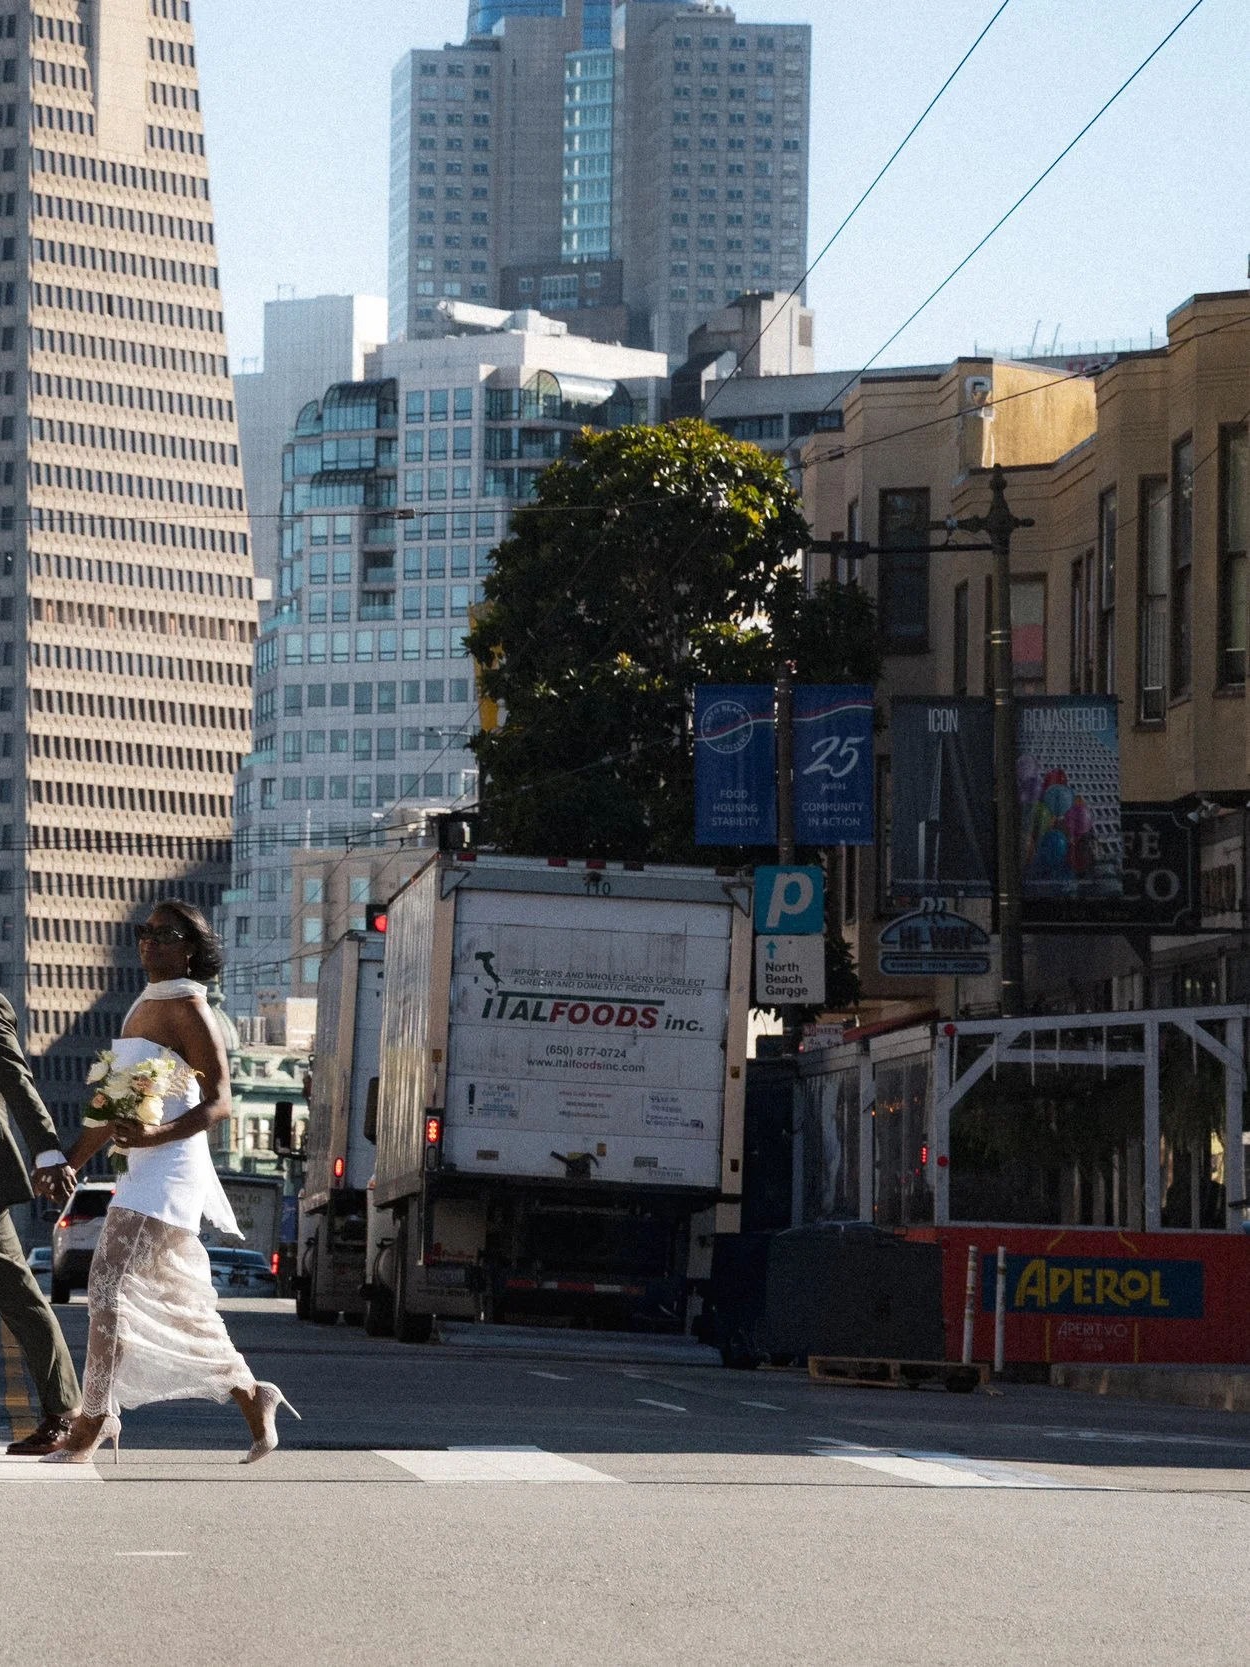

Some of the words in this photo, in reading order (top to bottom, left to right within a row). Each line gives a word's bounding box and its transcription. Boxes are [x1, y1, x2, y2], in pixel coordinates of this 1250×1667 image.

[928, 709, 958, 732] ICON
[1024, 708, 1108, 732] REMASTERED
[802, 736, 866, 778] 25
[720, 789, 748, 799] FOOD
[713, 803, 758, 813] HOUSING
[801, 802, 863, 812] COMMUNITY
[711, 818, 760, 827] STABILITY
[809, 818, 819, 827] IN
[822, 818, 861, 827] ACTION
[766, 962, 799, 973] North
[565, 970, 584, 980] AND
[658, 976, 668, 984] OF
[669, 977, 705, 987] SELECT
[765, 974, 803, 984] Beach
[555, 980, 575, 989] AND
[576, 981, 623, 991] DOMESTIC
[625, 983, 650, 993] FOOD
[652, 984, 703, 996] PRODUCTS
[765, 985, 808, 998] Garage
[664, 1014, 704, 1032] inc.
[546, 1044, 573, 1056] (650)
[576, 1046, 627, 1058] 877-0724
[527, 1057, 645, 1072] www.italfoodsinc.com
[1013, 1259, 1170, 1307] APEROL
